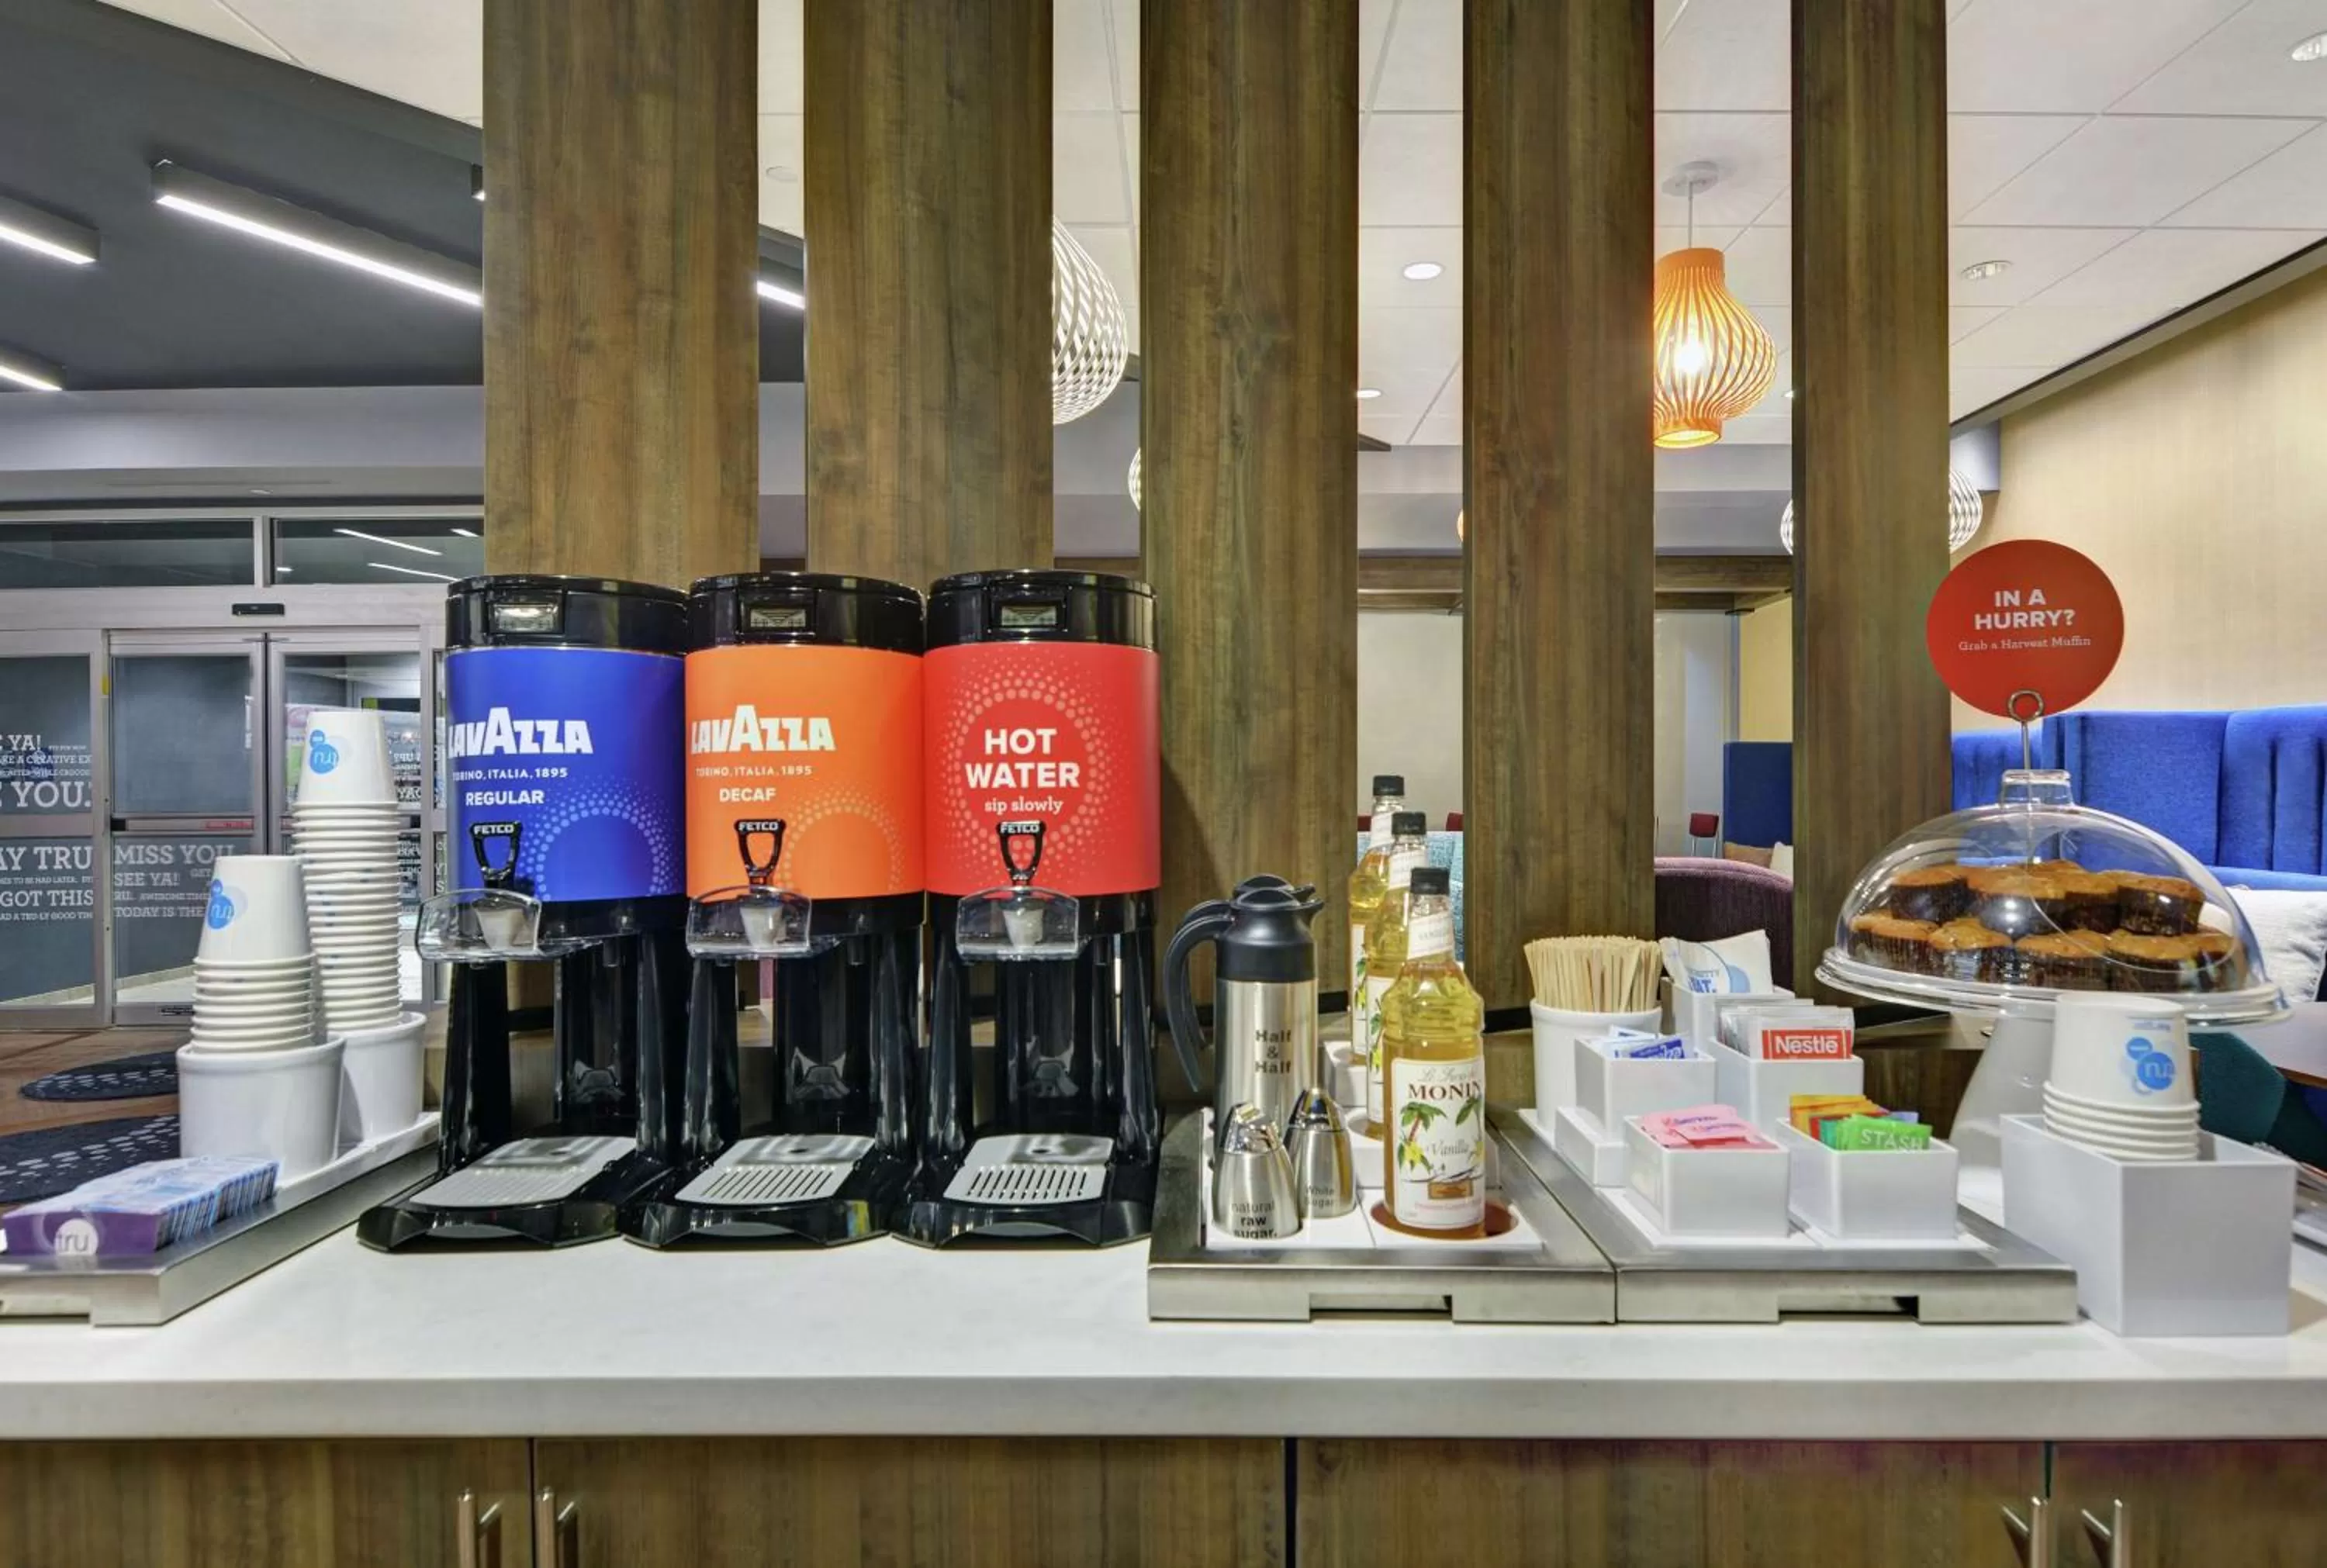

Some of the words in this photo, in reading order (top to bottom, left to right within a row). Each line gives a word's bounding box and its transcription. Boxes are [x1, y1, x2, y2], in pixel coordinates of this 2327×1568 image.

[1994, 590, 2021, 607] IN
[2028, 589, 2047, 606] A
[1974, 609, 2076, 630] HURRY?
[1959, 639, 1988, 651] Grab
[1991, 641, 1998, 650] a
[2000, 637, 2049, 650] Harvest
[2052, 635, 2092, 647] Muffin
[448, 706, 594, 759] LAVAZZA
[691, 704, 837, 755] LAVAZZA
[984, 728, 1057, 755] HOT
[965, 762, 1081, 789] WATER
[465, 790, 545, 806] REGULAR
[719, 787, 776, 803] DECAF
[984, 797, 1008, 815] sip
[1011, 796, 1064, 815] slowly
[473, 824, 516, 835] FETCO
[738, 821, 779, 832] FETCO
[33, 846, 93, 870] TRU
[114, 844, 174, 865] MISS
[114, 872, 145, 886] SEE
[0, 891, 42, 907] GOT
[47, 889, 93, 906] THIS
[114, 907, 159, 917] TODAY
[1255, 1029, 1291, 1043] Half
[1266, 1045, 1279, 1059] &
[1254, 1060, 1291, 1074] Half
[1232, 1200, 1275, 1214] natural
[1241, 1215, 1267, 1226] raw
